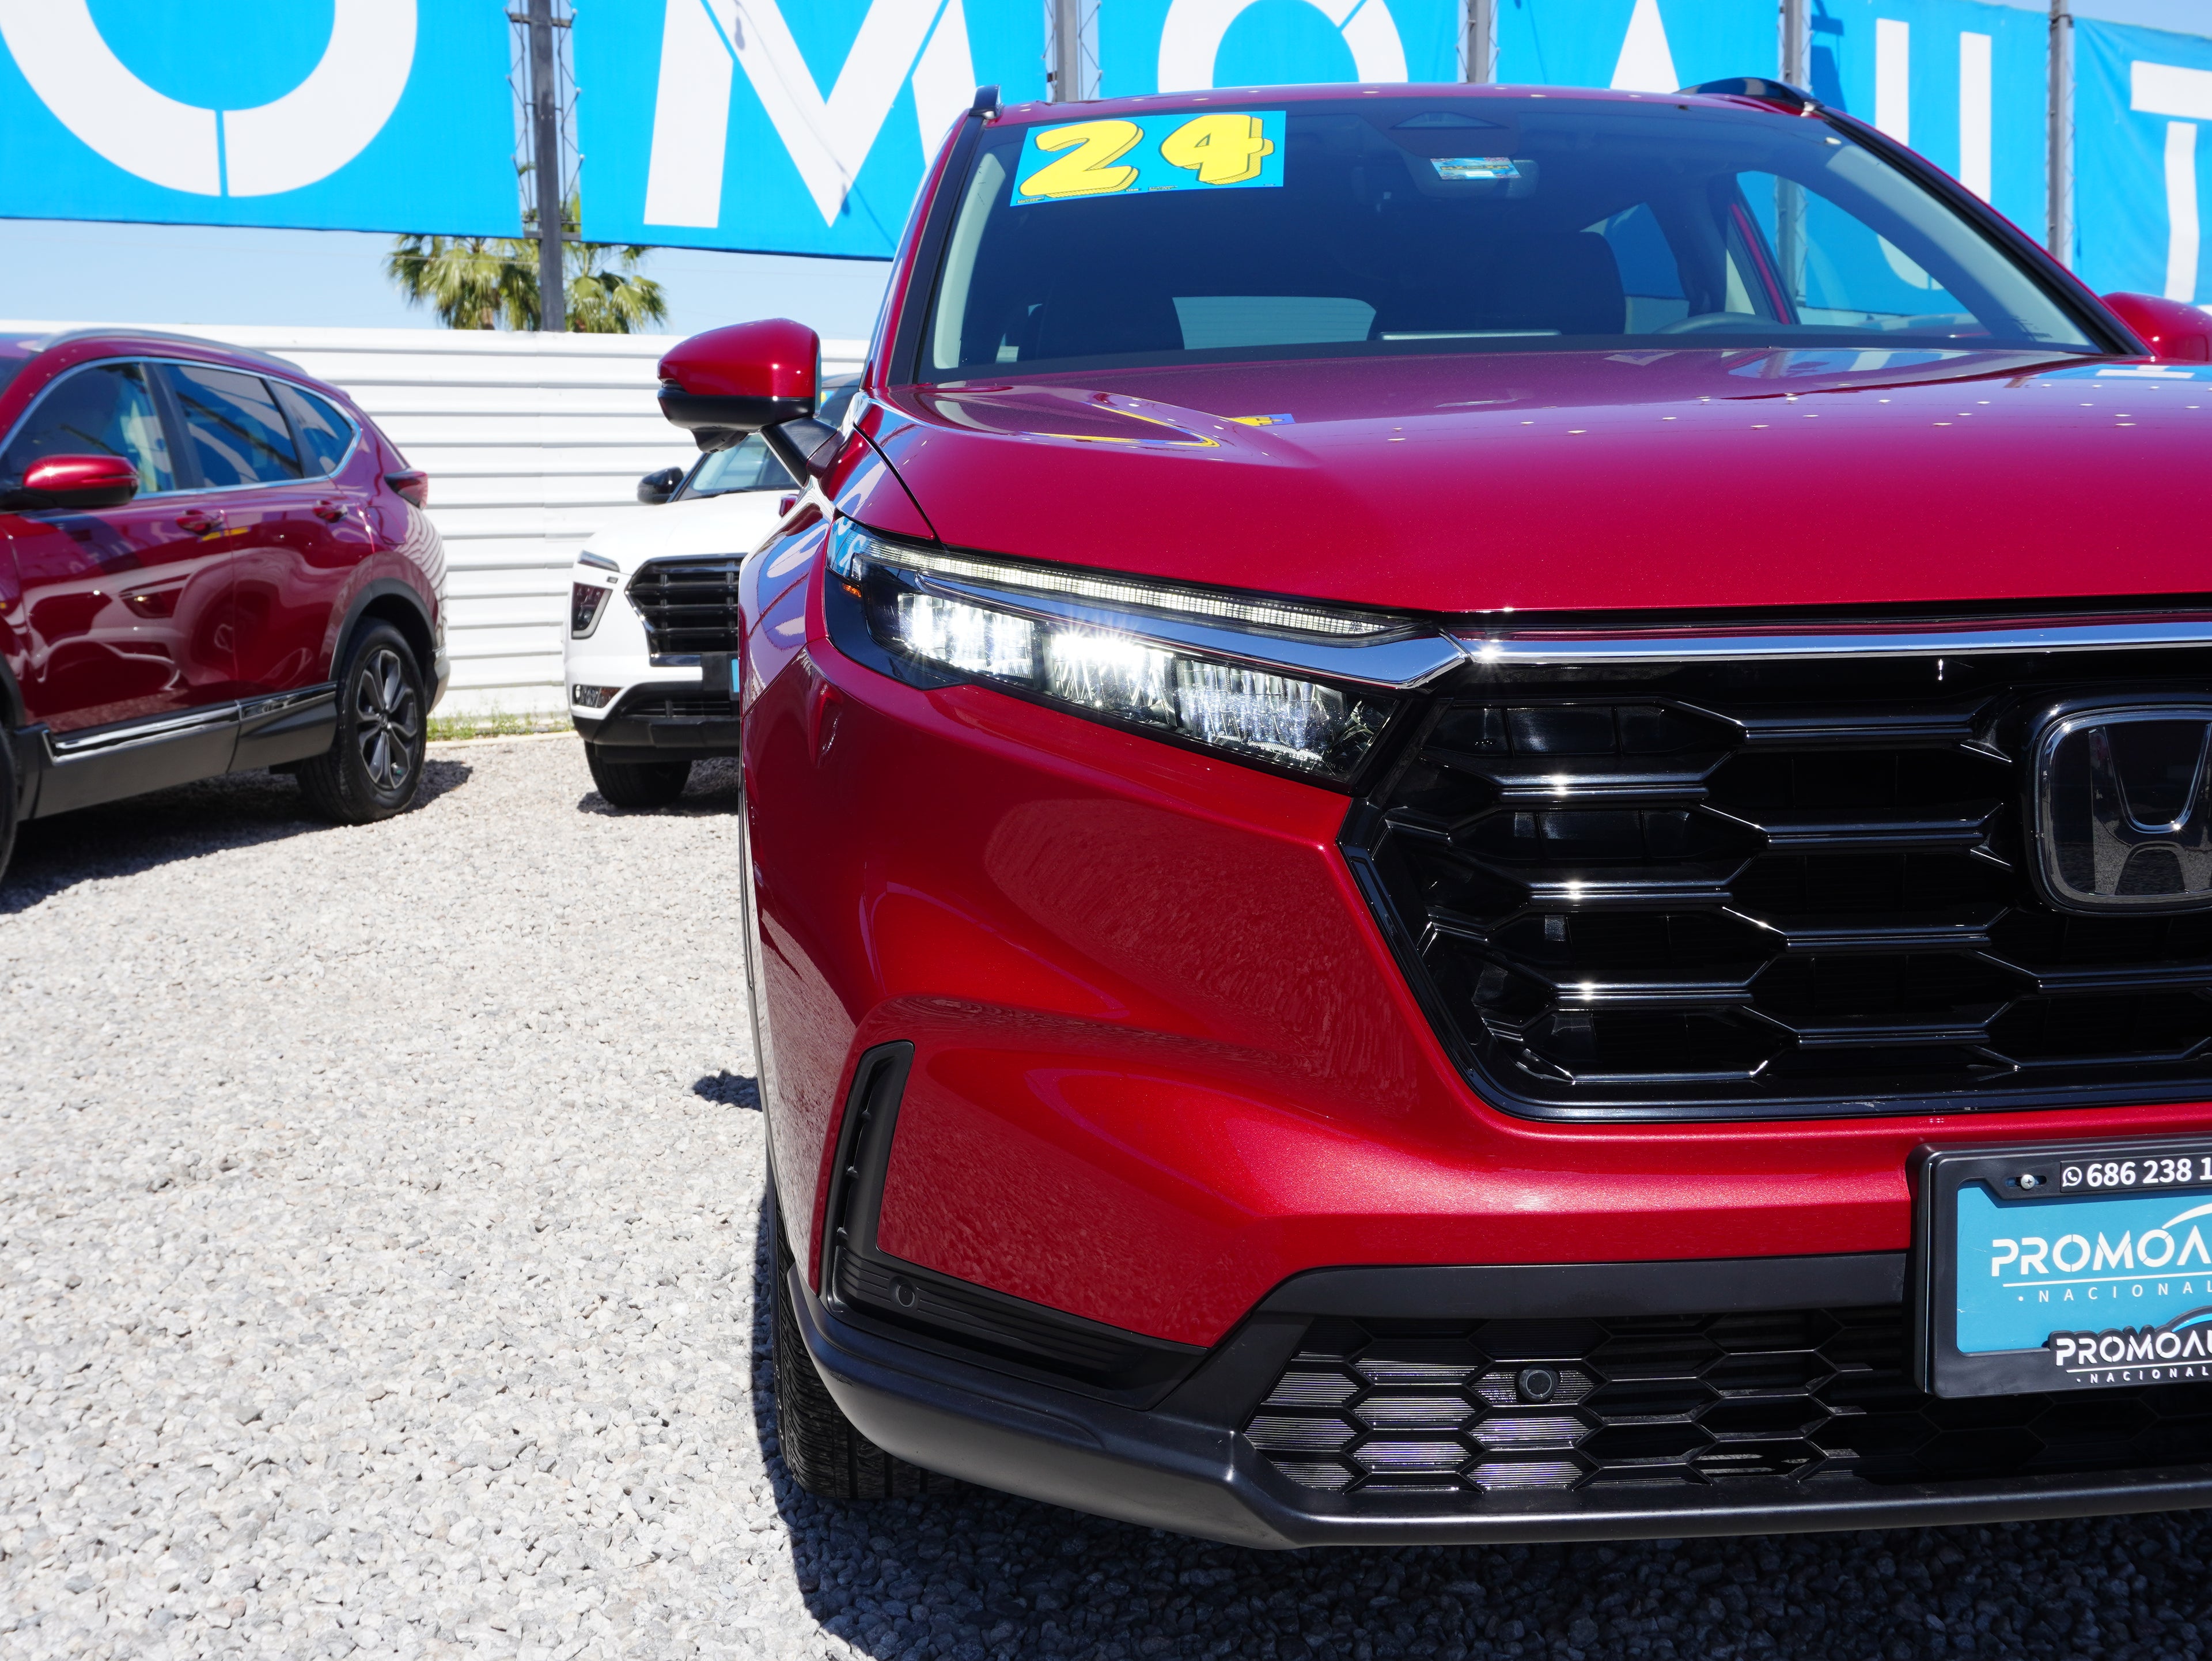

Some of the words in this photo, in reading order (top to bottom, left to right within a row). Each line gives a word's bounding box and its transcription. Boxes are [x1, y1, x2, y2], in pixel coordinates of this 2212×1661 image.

[1019, 115, 1275, 198] 24
[2087, 1161, 2136, 1187] 686
[2142, 1158, 2192, 1183] 238
[2056, 1329, 2212, 1367] PROMOA
[2090, 1365, 2209, 1384] NACIONAL
